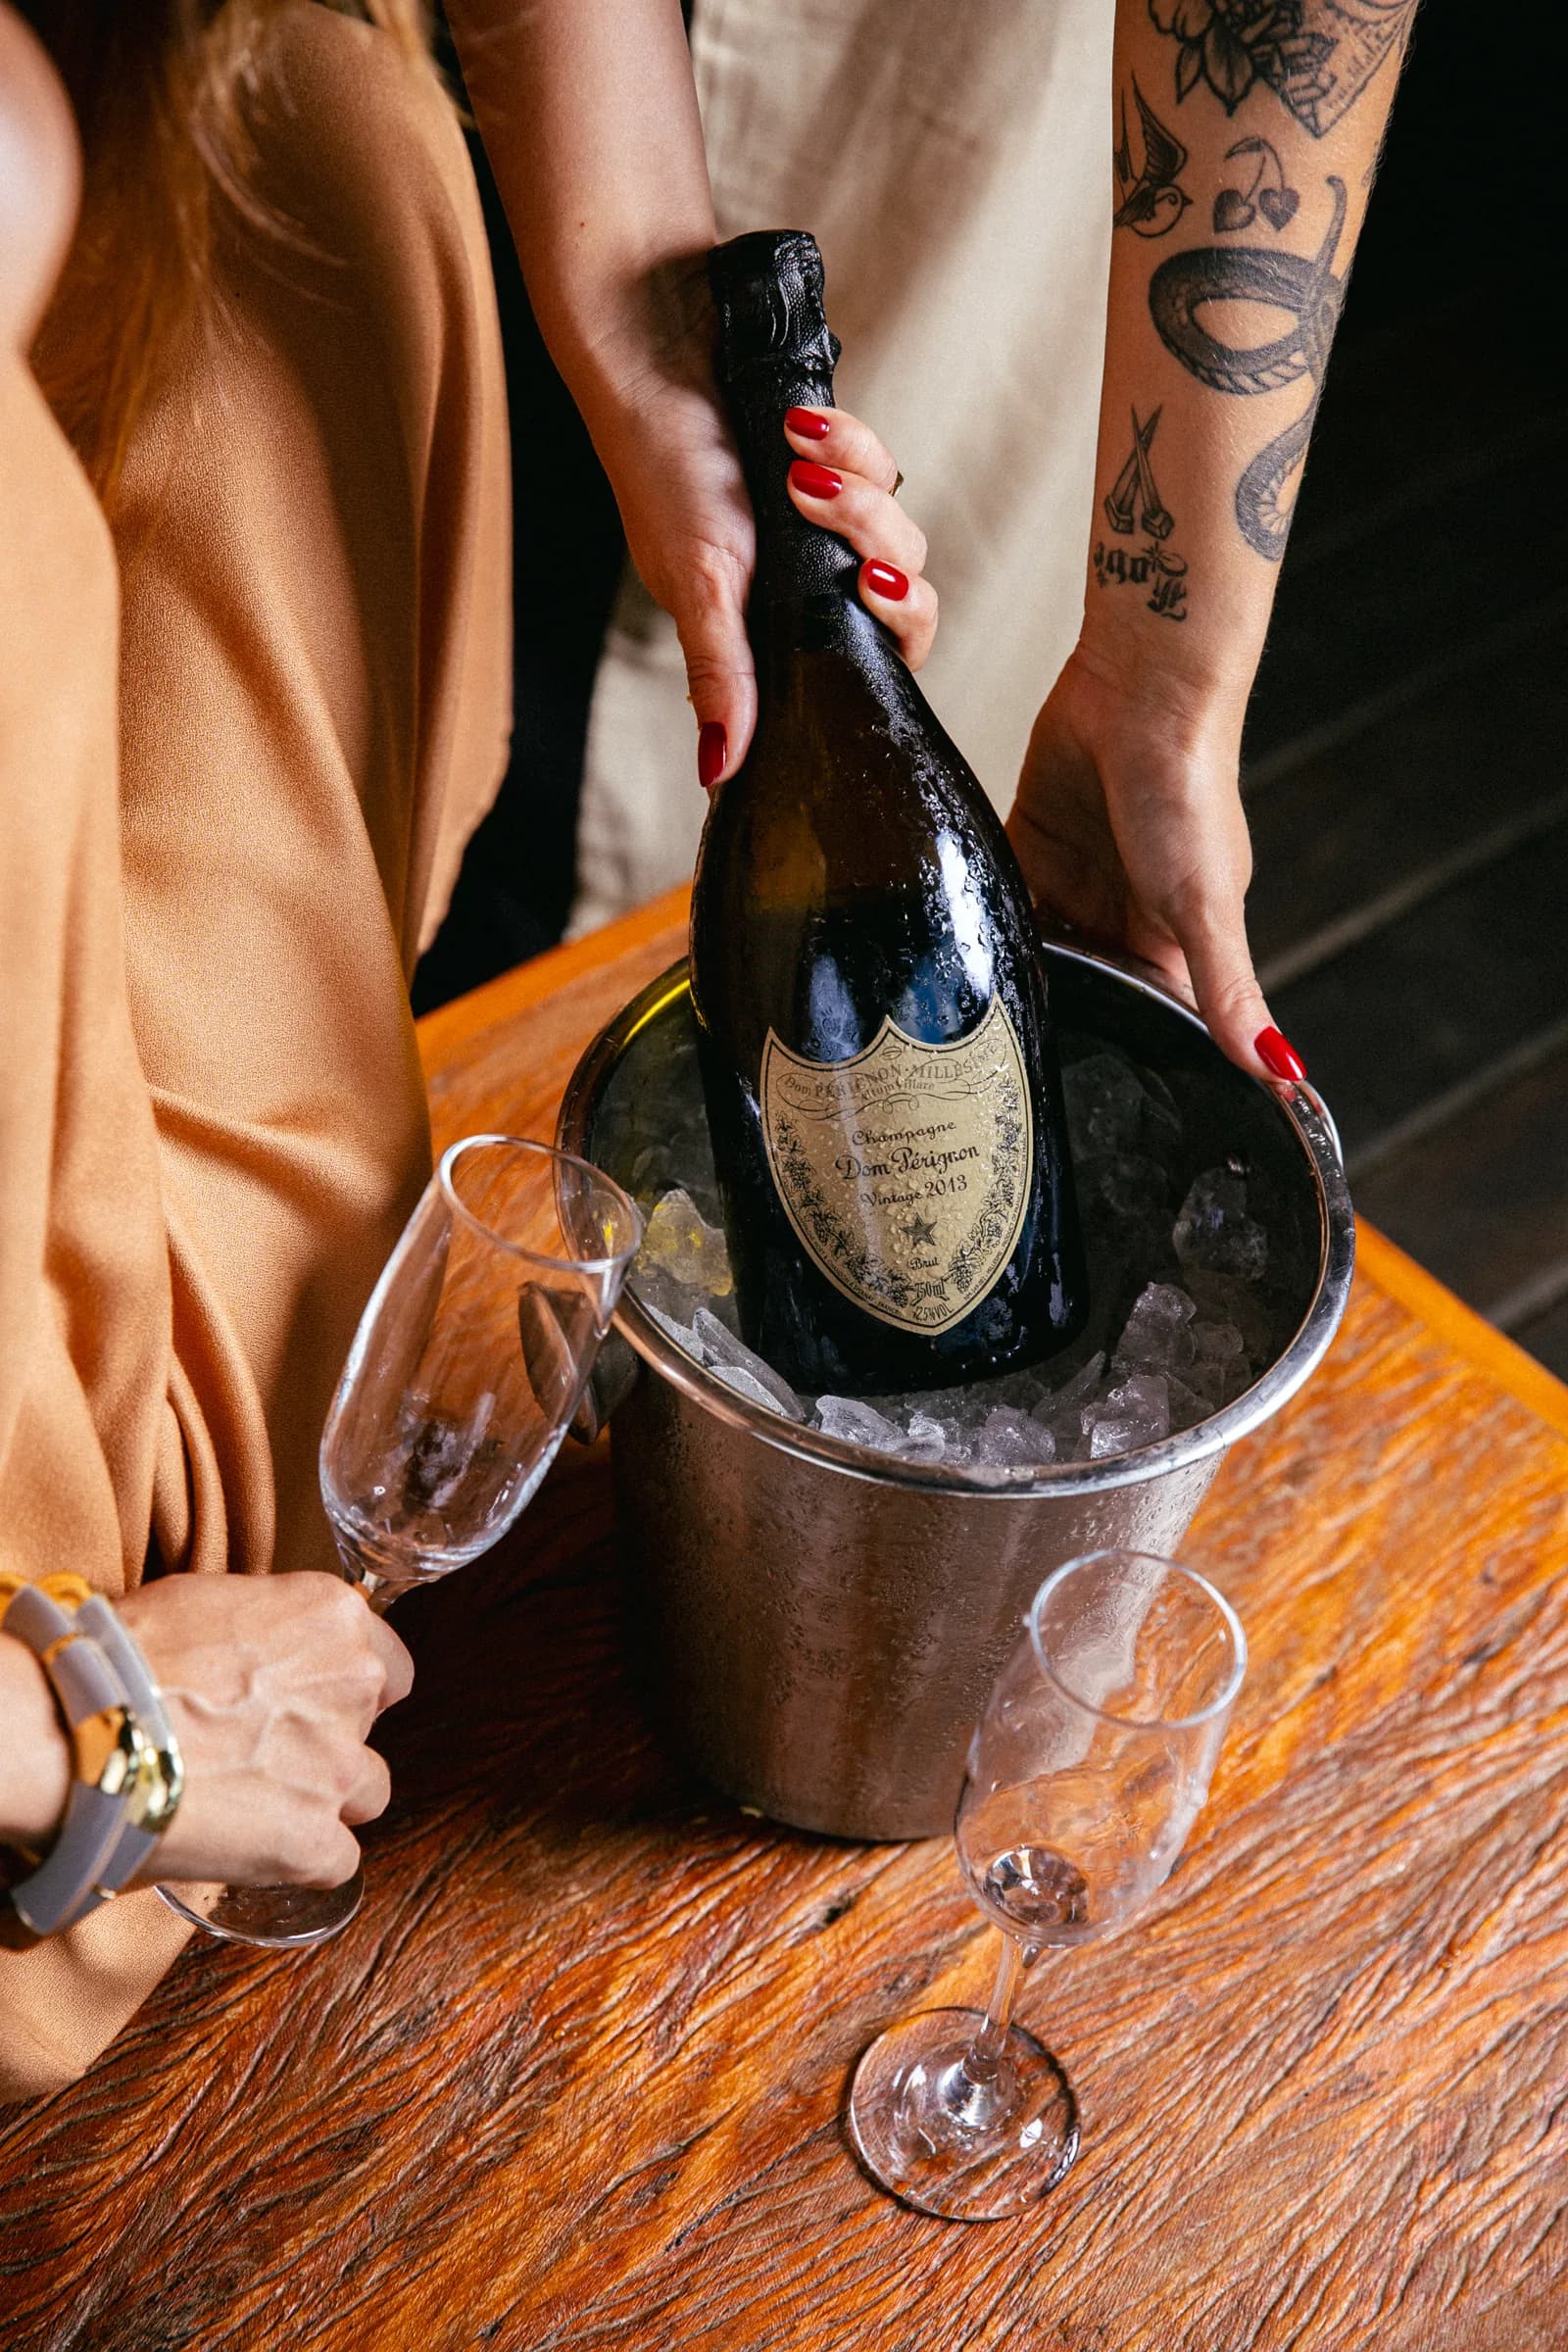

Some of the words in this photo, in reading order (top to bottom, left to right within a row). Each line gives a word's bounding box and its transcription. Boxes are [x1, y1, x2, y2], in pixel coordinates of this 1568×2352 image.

[852, 1121, 956, 1147] Champagne
[835, 1154, 891, 1181] Dom
[891, 1145, 980, 1176] Pérignon
[860, 1191, 922, 1208] Vintage
[924, 1175, 968, 1200] 2013
[909, 1257, 939, 1271] Brut
